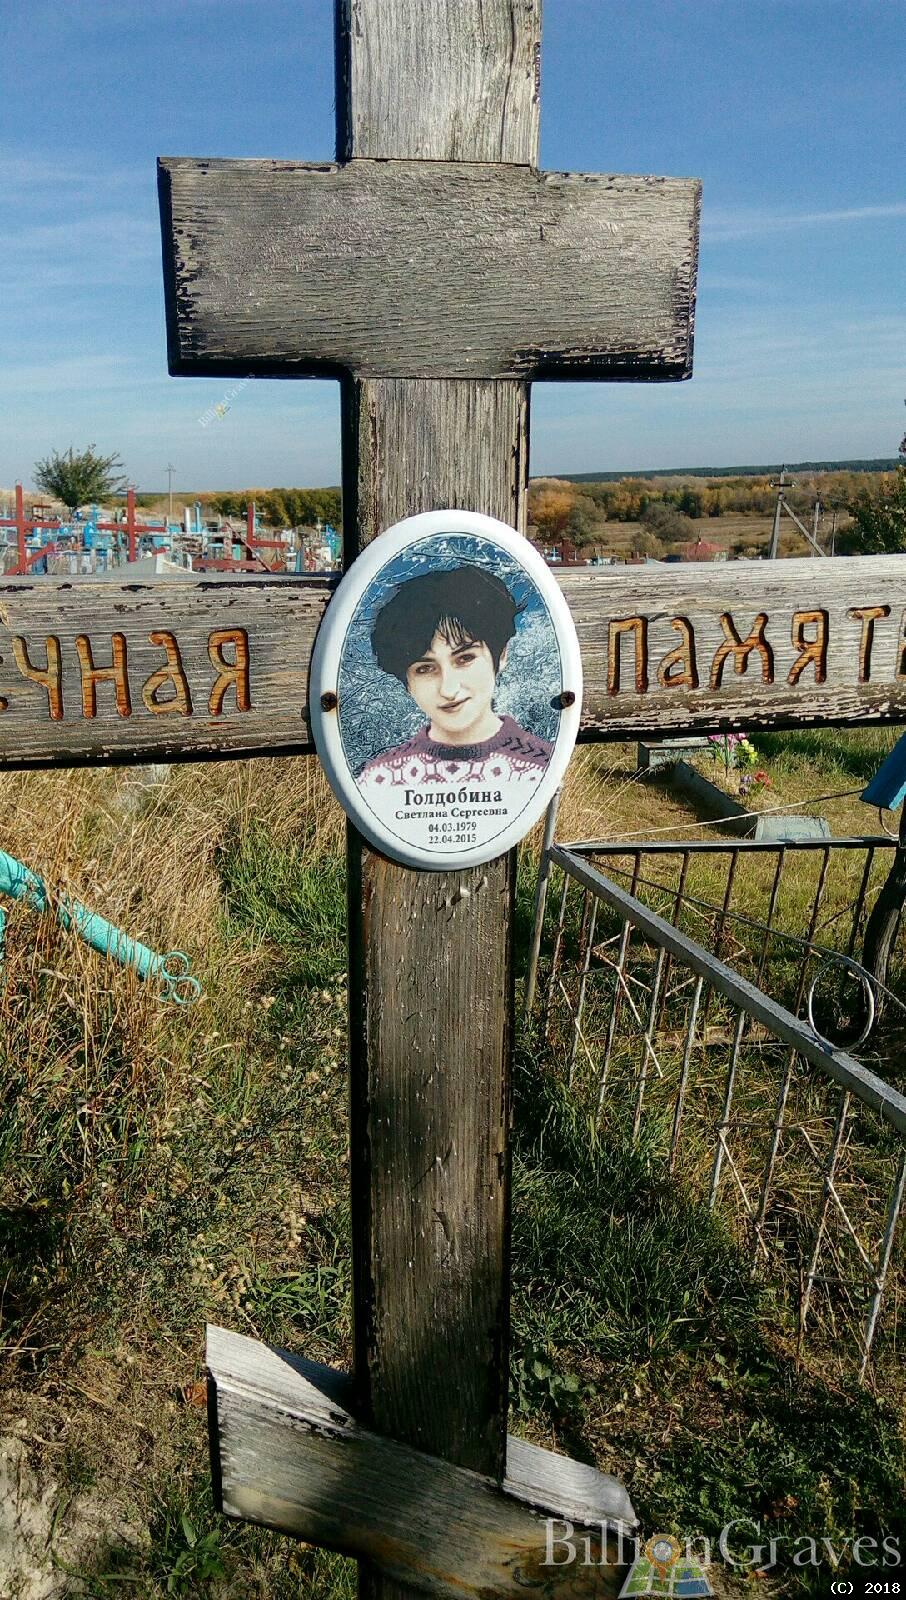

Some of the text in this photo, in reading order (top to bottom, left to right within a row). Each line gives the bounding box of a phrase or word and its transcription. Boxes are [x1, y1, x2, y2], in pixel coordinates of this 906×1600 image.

[404, 787, 502, 807] Голдобина
[395, 807, 508, 820] Светлана Сергеевна
[428, 821, 477, 832] 04.03.1979
[428, 833, 477, 844] 22.04.2015
